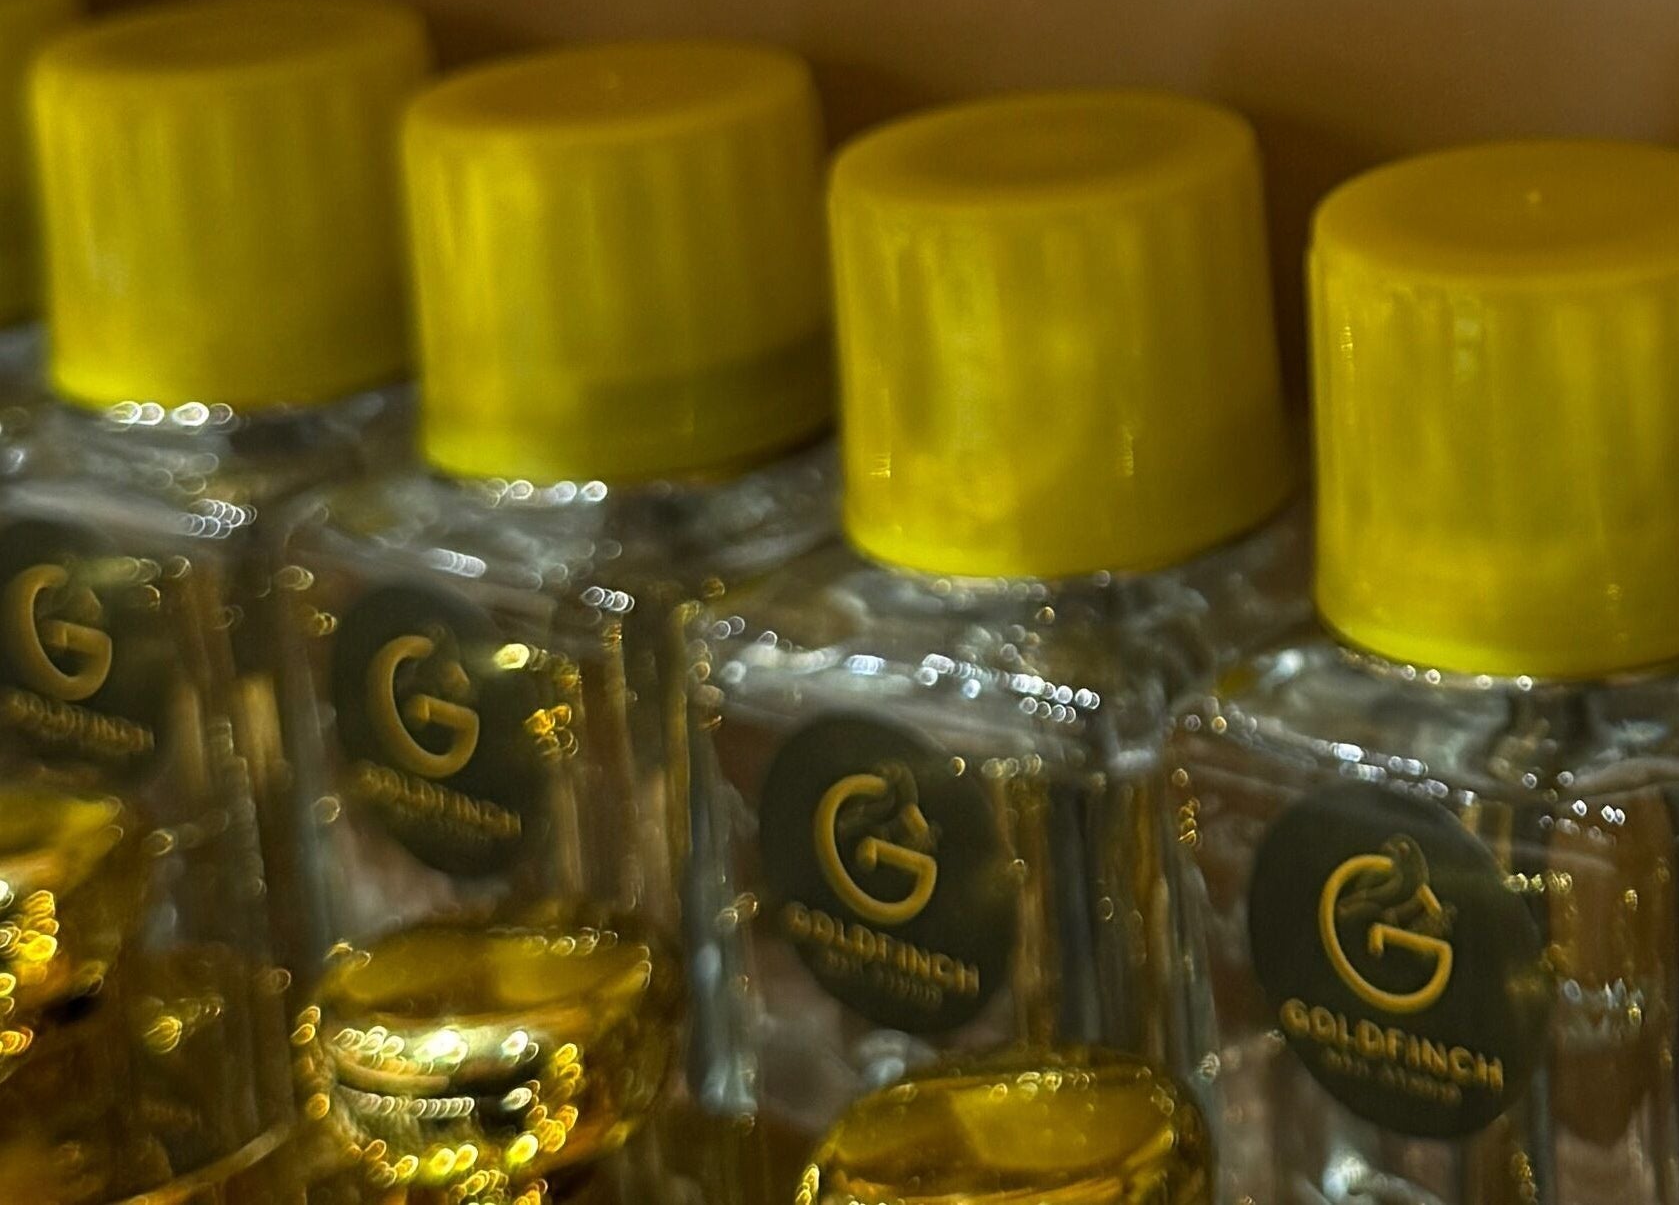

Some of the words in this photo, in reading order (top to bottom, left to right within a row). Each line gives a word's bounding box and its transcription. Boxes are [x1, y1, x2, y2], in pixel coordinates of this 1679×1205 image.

[813, 772, 939, 925] G
[784, 901, 980, 995] GOLDFINCH
[1318, 853, 1454, 1013] G
[1280, 998, 1504, 1091] GOLDFINCH
